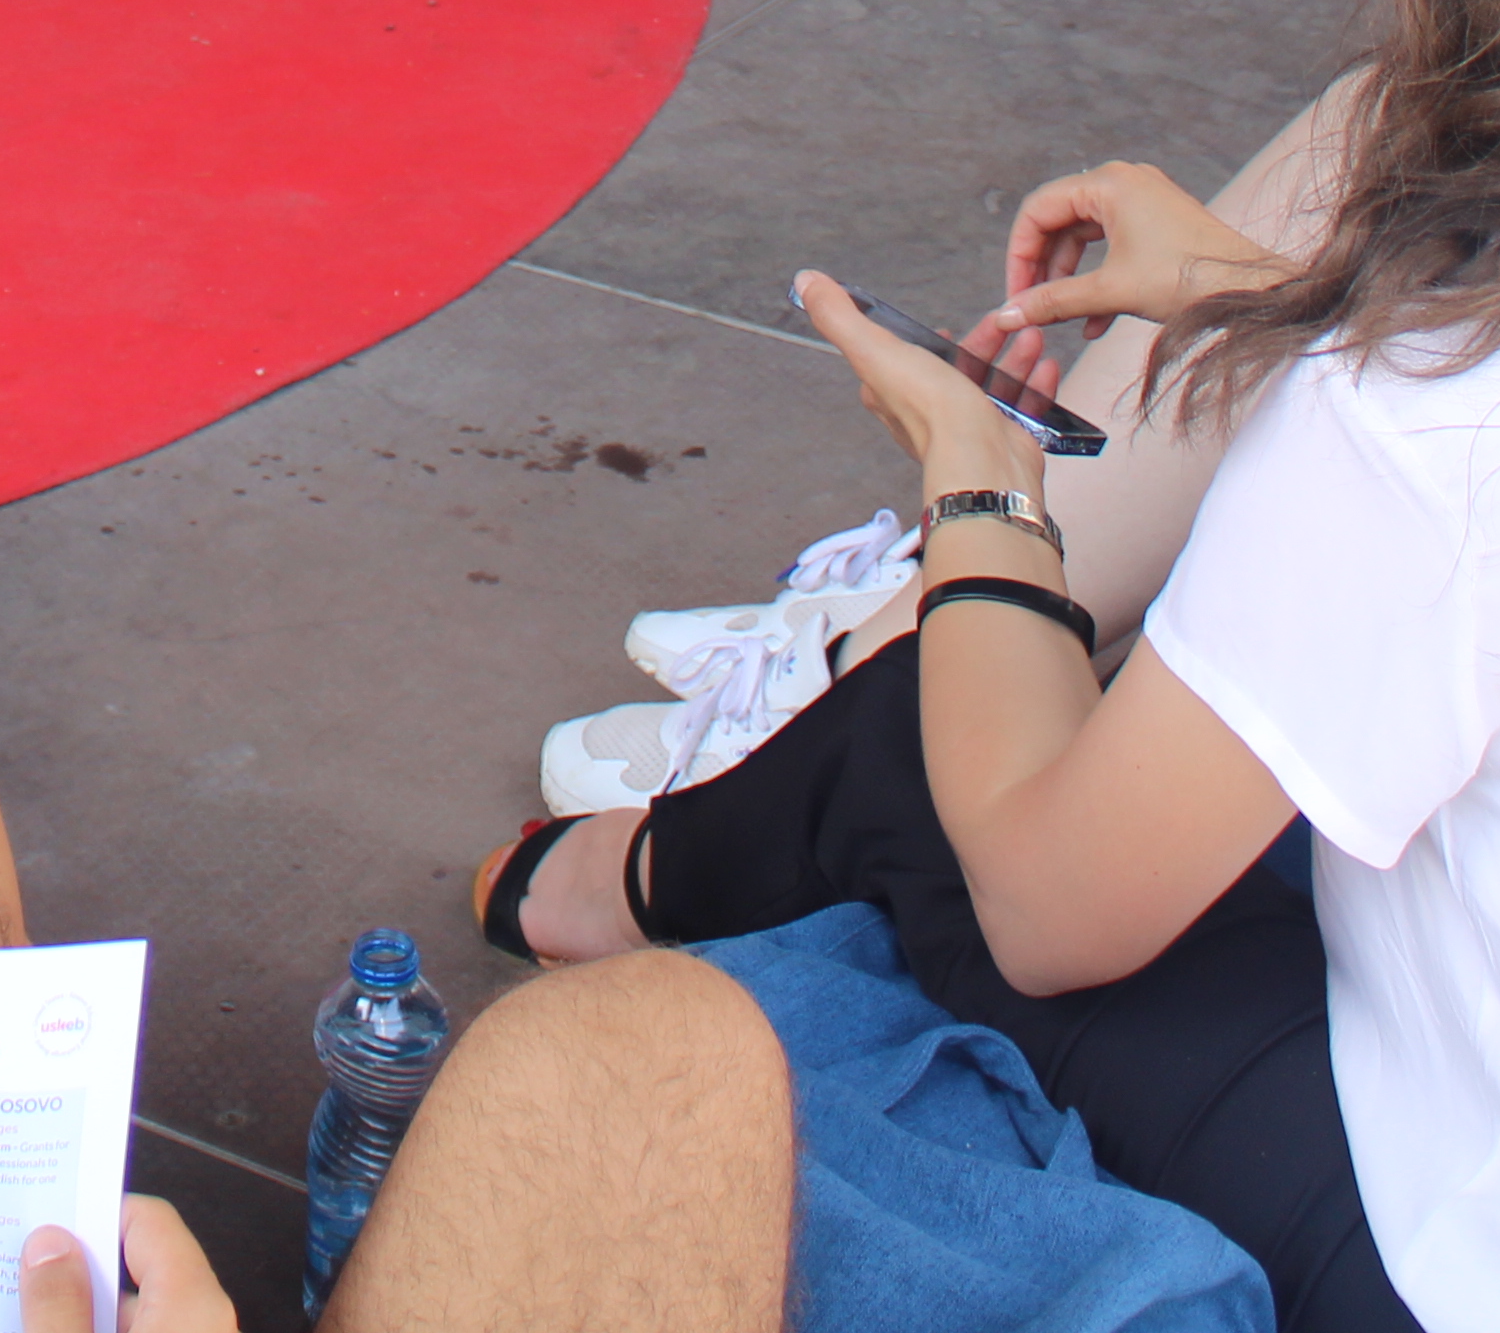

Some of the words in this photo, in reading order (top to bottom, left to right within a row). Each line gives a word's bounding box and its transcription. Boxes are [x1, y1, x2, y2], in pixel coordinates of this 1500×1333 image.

[40, 1016, 85, 1033] uskeb
[20, 1141, 53, 1153] Grants
[55, 1140, 70, 1150] for
[47, 1157, 58, 1167] to
[21, 1173, 37, 1185] for
[39, 1174, 56, 1184] one
